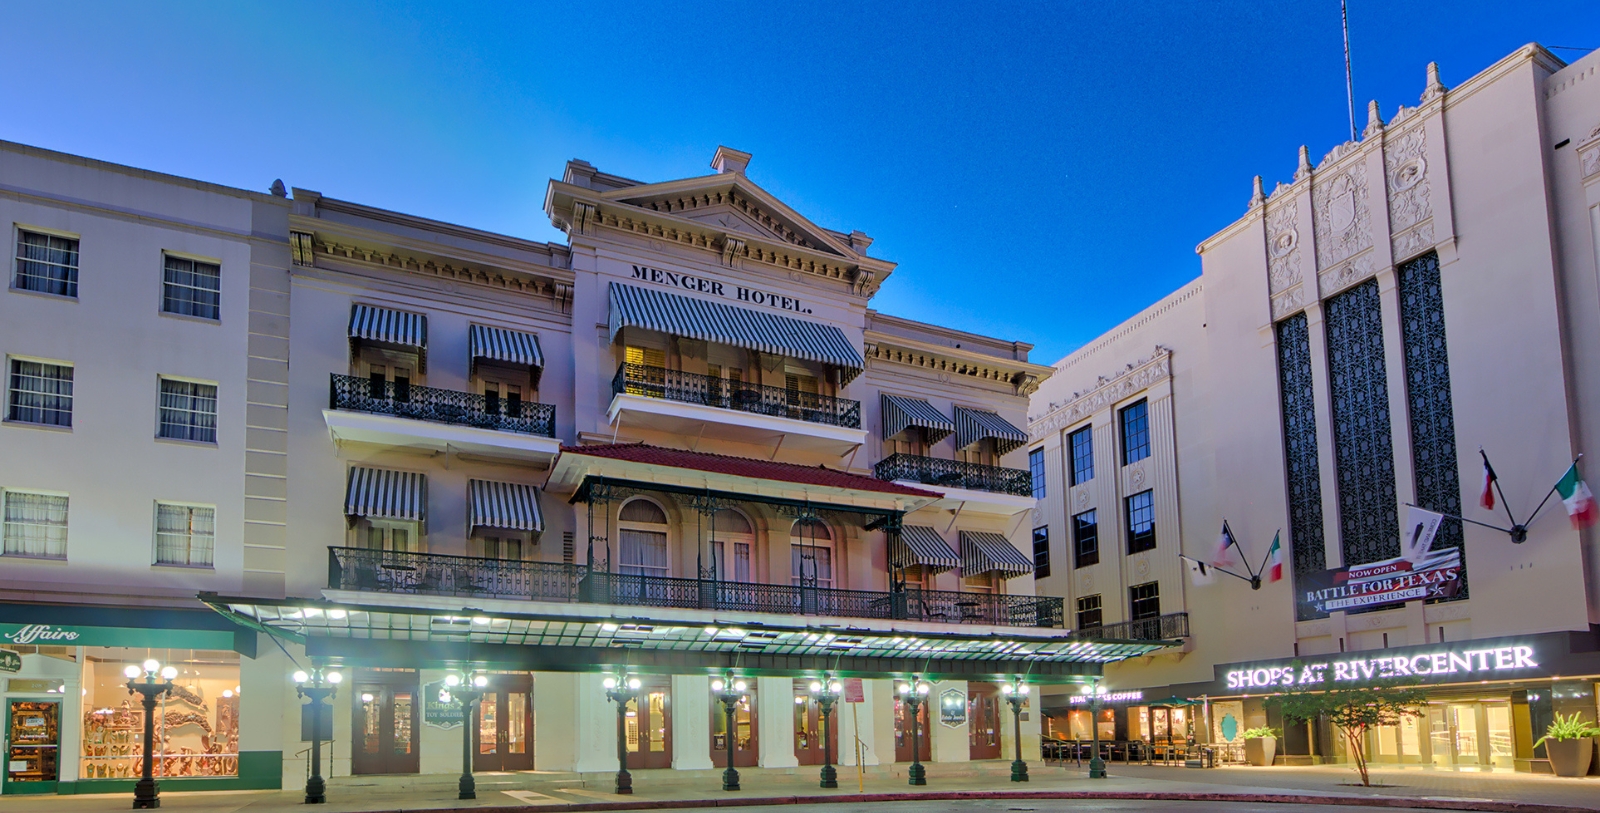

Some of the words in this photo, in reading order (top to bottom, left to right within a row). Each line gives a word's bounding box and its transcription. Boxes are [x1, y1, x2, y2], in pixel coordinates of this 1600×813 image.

[631, 265, 725, 296] MENGER
[1349, 569, 1371, 578] NOW
[1373, 564, 1397, 575] OPEN
[1306, 585, 1359, 602] BATTLE
[1361, 578, 1394, 594] FOR
[1395, 568, 1458, 588] TEXAS
[1329, 599, 1350, 608] THE
[1353, 589, 1421, 605] EXPERIENCE
[4, 624, 80, 643] Affairs
[1227, 666, 1294, 688] SHOPS
[1298, 663, 1328, 684] AT
[1333, 646, 1538, 681] RIVERCENTER
[1112, 692, 1142, 700] COFFEE
